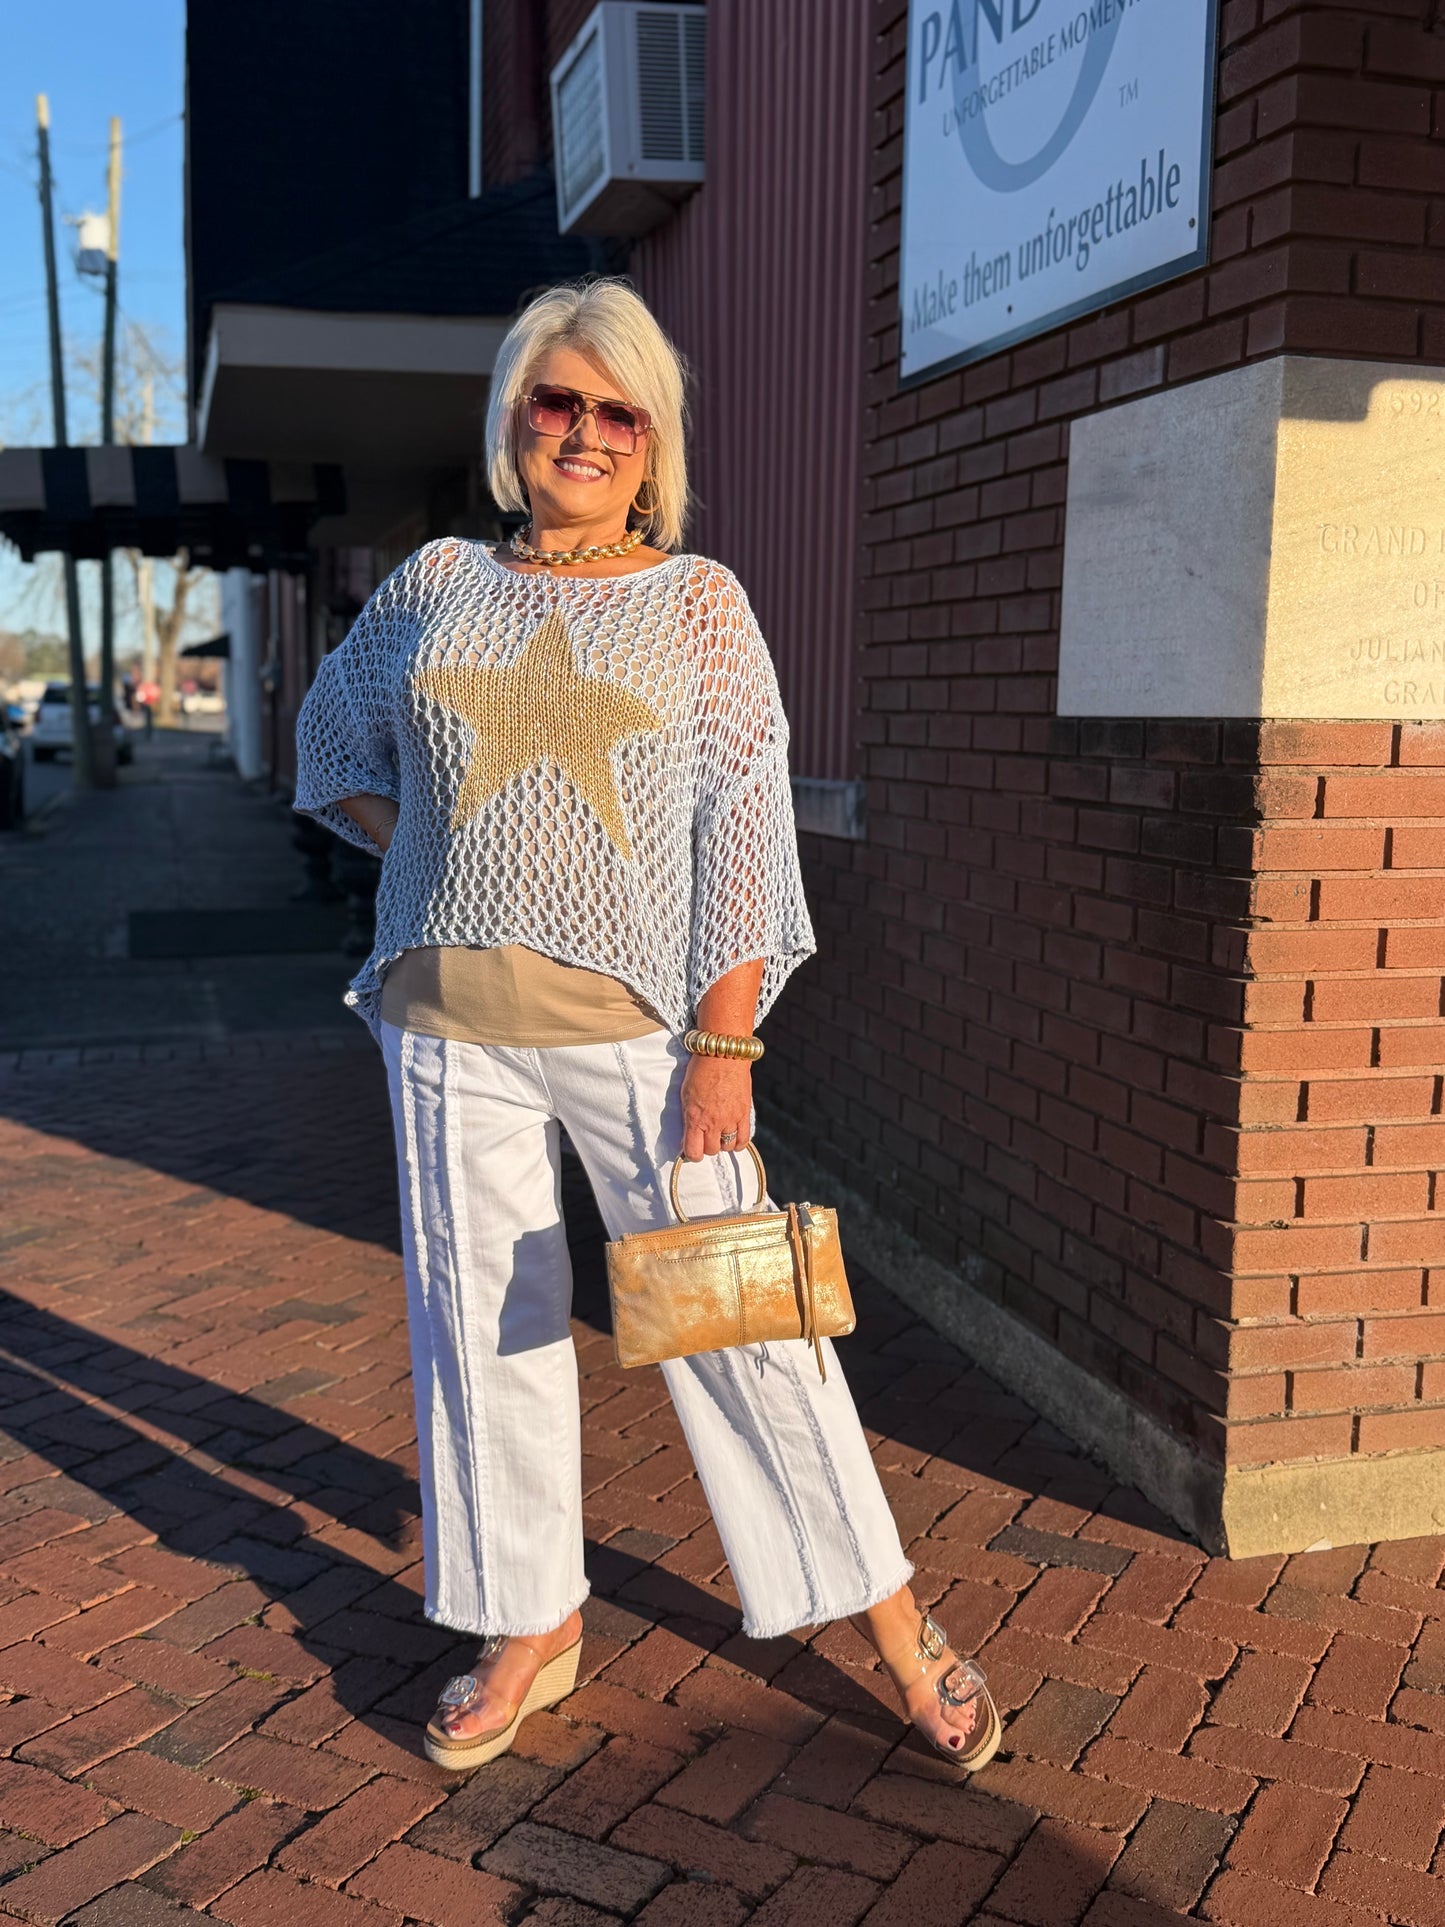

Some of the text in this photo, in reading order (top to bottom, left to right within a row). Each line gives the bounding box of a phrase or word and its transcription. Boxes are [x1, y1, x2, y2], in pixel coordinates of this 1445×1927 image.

[942, 0, 1140, 137] UNFORGETTABLE MOMEN
[1118, 78, 1139, 108] TM
[911, 148, 1181, 333] Make them unforgettable
[1320, 523, 1426, 556] GRAND
[1383, 680, 1445, 704] GRA
